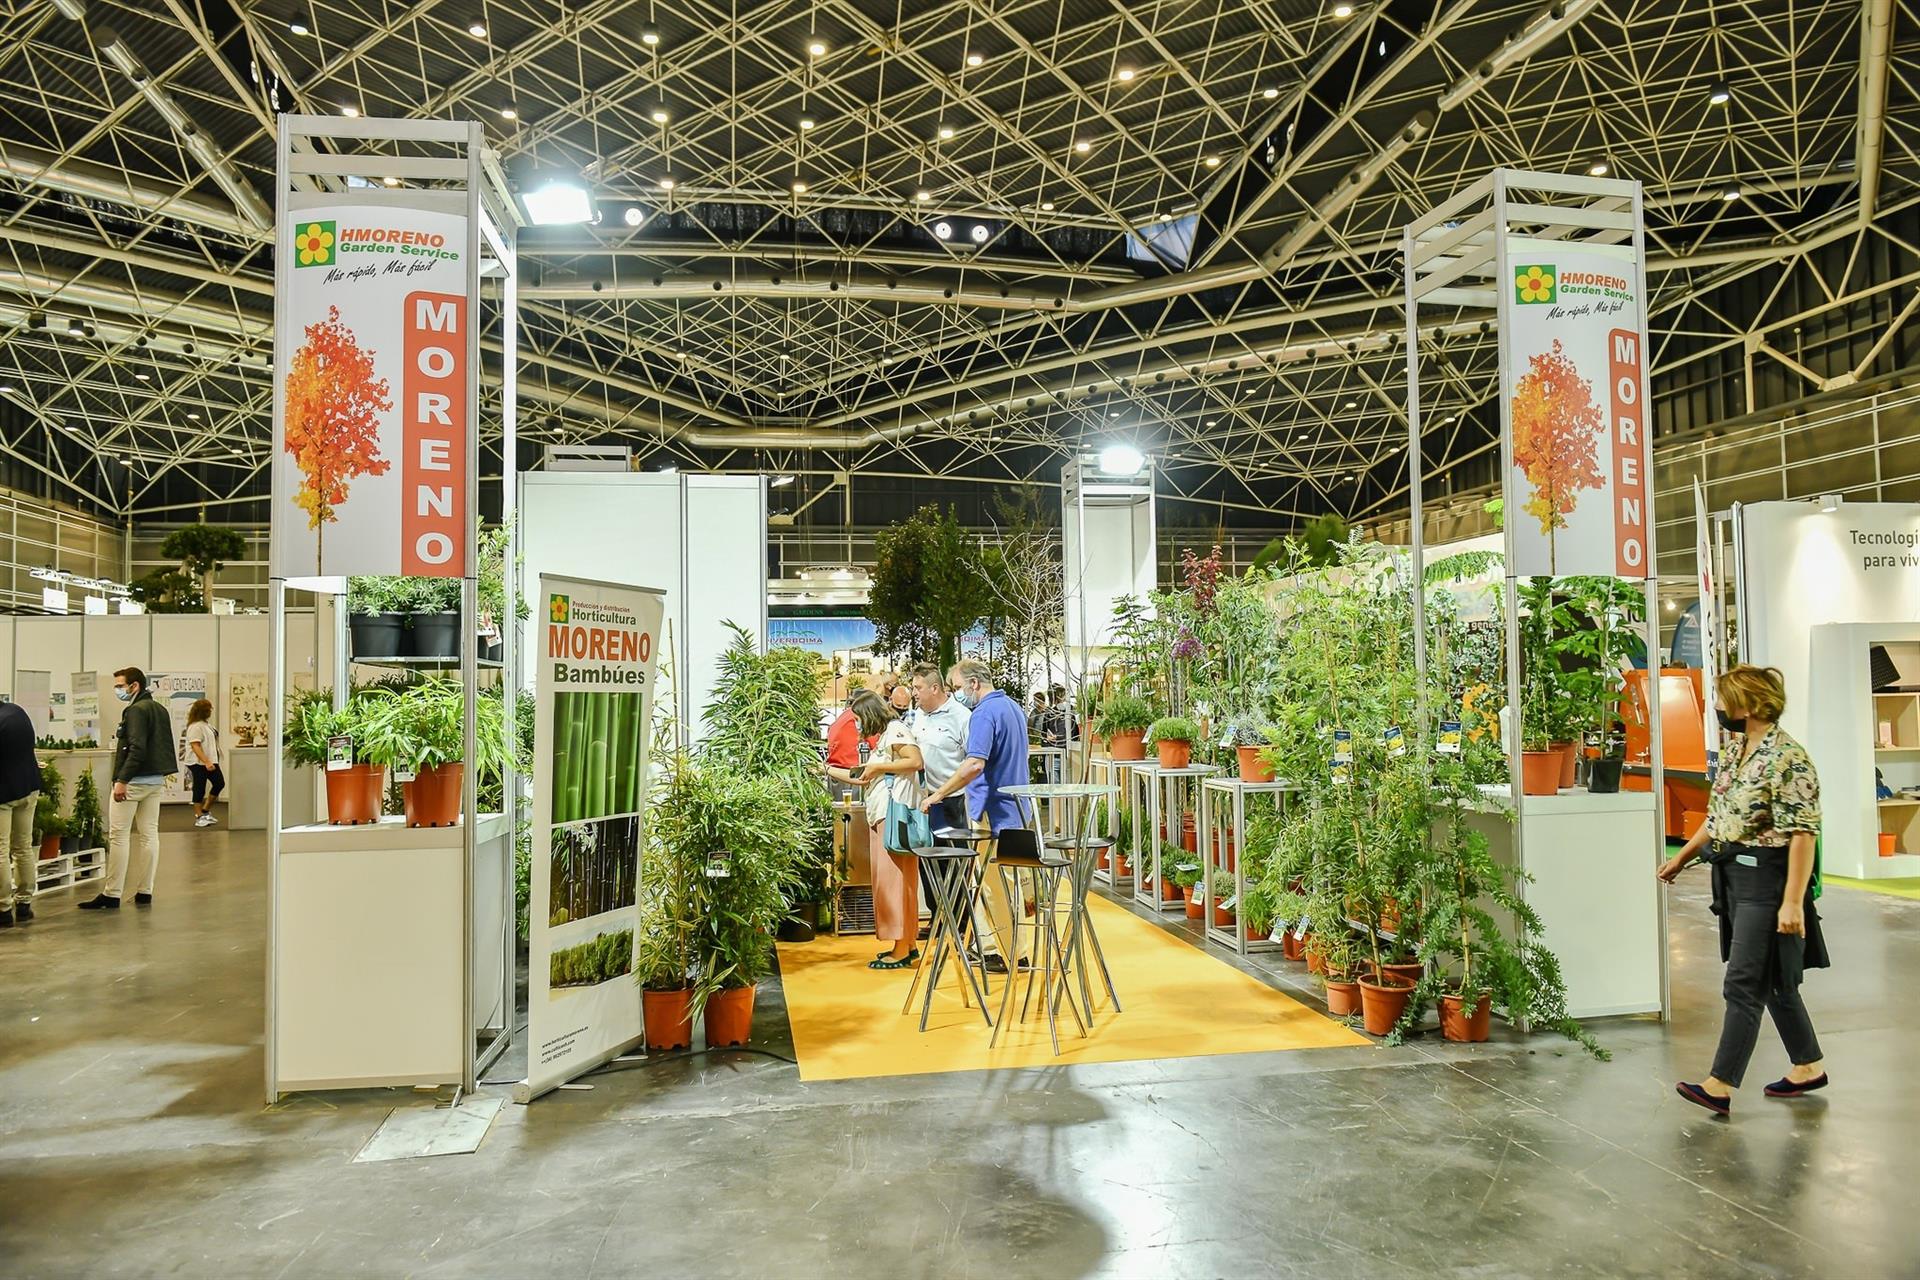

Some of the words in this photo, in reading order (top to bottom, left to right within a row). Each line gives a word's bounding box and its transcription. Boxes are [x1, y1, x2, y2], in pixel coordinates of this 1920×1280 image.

[341, 229, 445, 248] HMORENO
[340, 243, 395, 253] Garden
[400, 245, 459, 261] Service
[323, 268, 344, 284] Más
[382, 260, 406, 275] Más
[407, 259, 437, 276] fácil
[1560, 272, 1627, 291] HMORENO
[1560, 284, 1601, 296] Garden
[1604, 288, 1634, 302] Service
[1546, 306, 1565, 320] Más
[416, 299, 456, 564] MORENO
[1615, 336, 1641, 567] MORENO
[1863, 556, 1896, 571] para
[572, 607, 637, 625] Horticultura
[549, 625, 651, 663] MORENO
[554, 663, 646, 684] Bambúes
